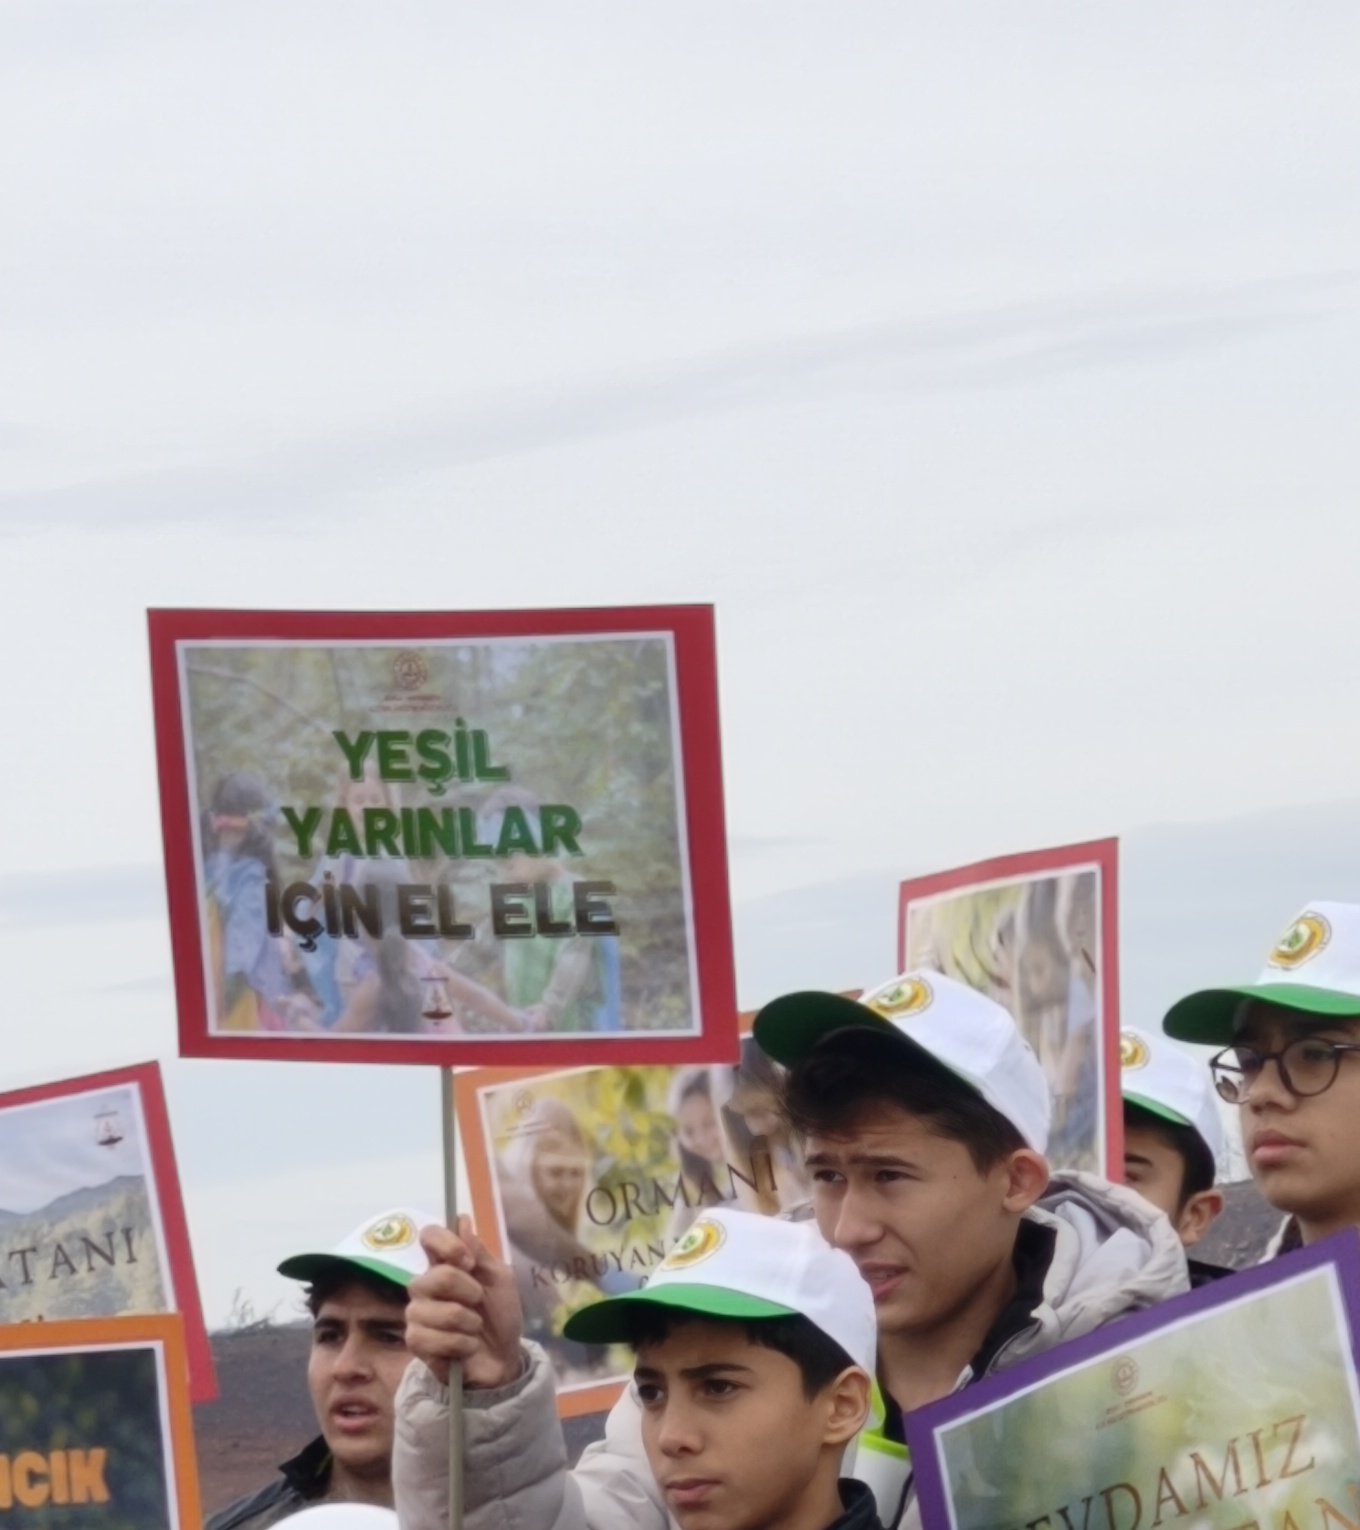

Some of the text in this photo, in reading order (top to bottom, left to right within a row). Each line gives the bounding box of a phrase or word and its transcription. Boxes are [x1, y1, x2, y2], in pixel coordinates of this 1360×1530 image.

[332, 717, 511, 796] YEŞİL
[281, 804, 584, 860] YARINLAR
[264, 871, 620, 952] İÇİN EL ELE
[586, 1152, 778, 1226] ORMANI
